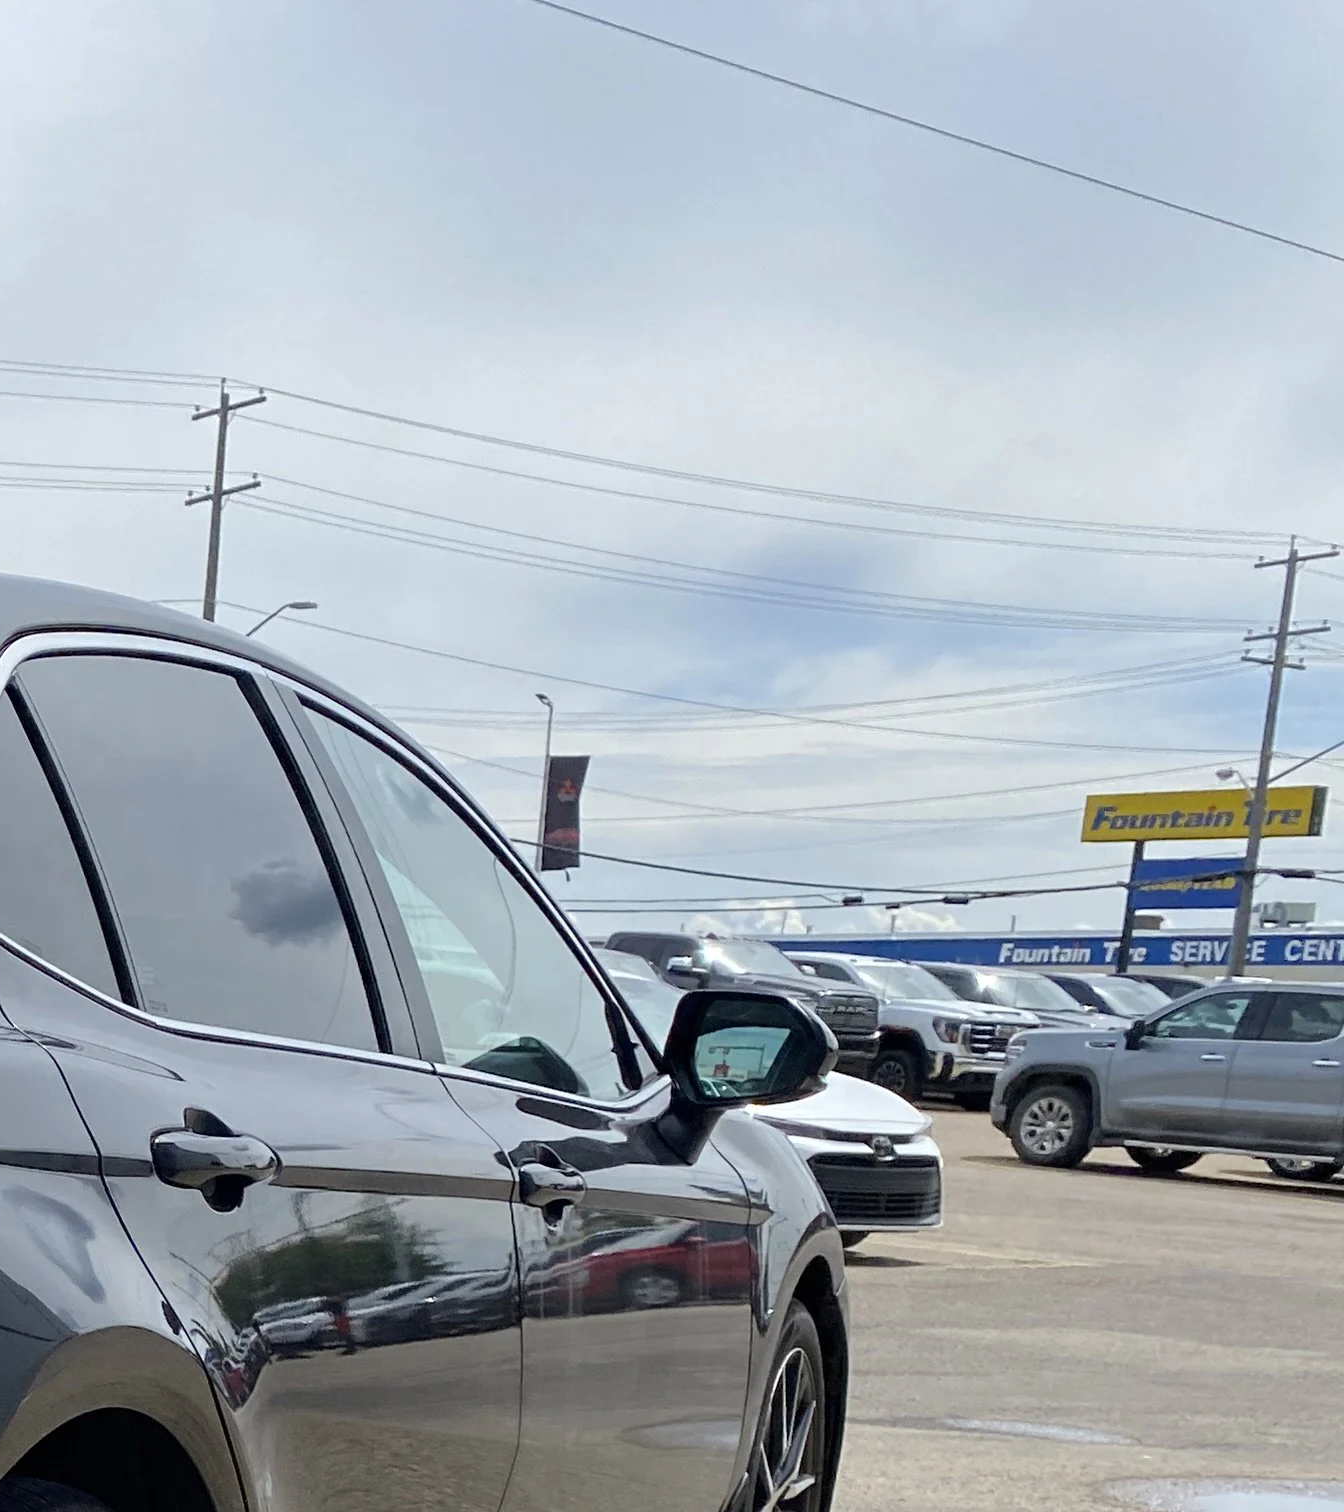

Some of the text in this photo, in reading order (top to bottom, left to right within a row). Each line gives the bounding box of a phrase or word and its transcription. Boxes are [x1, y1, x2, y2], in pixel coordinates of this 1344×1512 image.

[1091, 800, 1302, 831] Fountain Tre
[998, 941, 1091, 963] Fountain
[1170, 940, 1266, 963] SERVE
